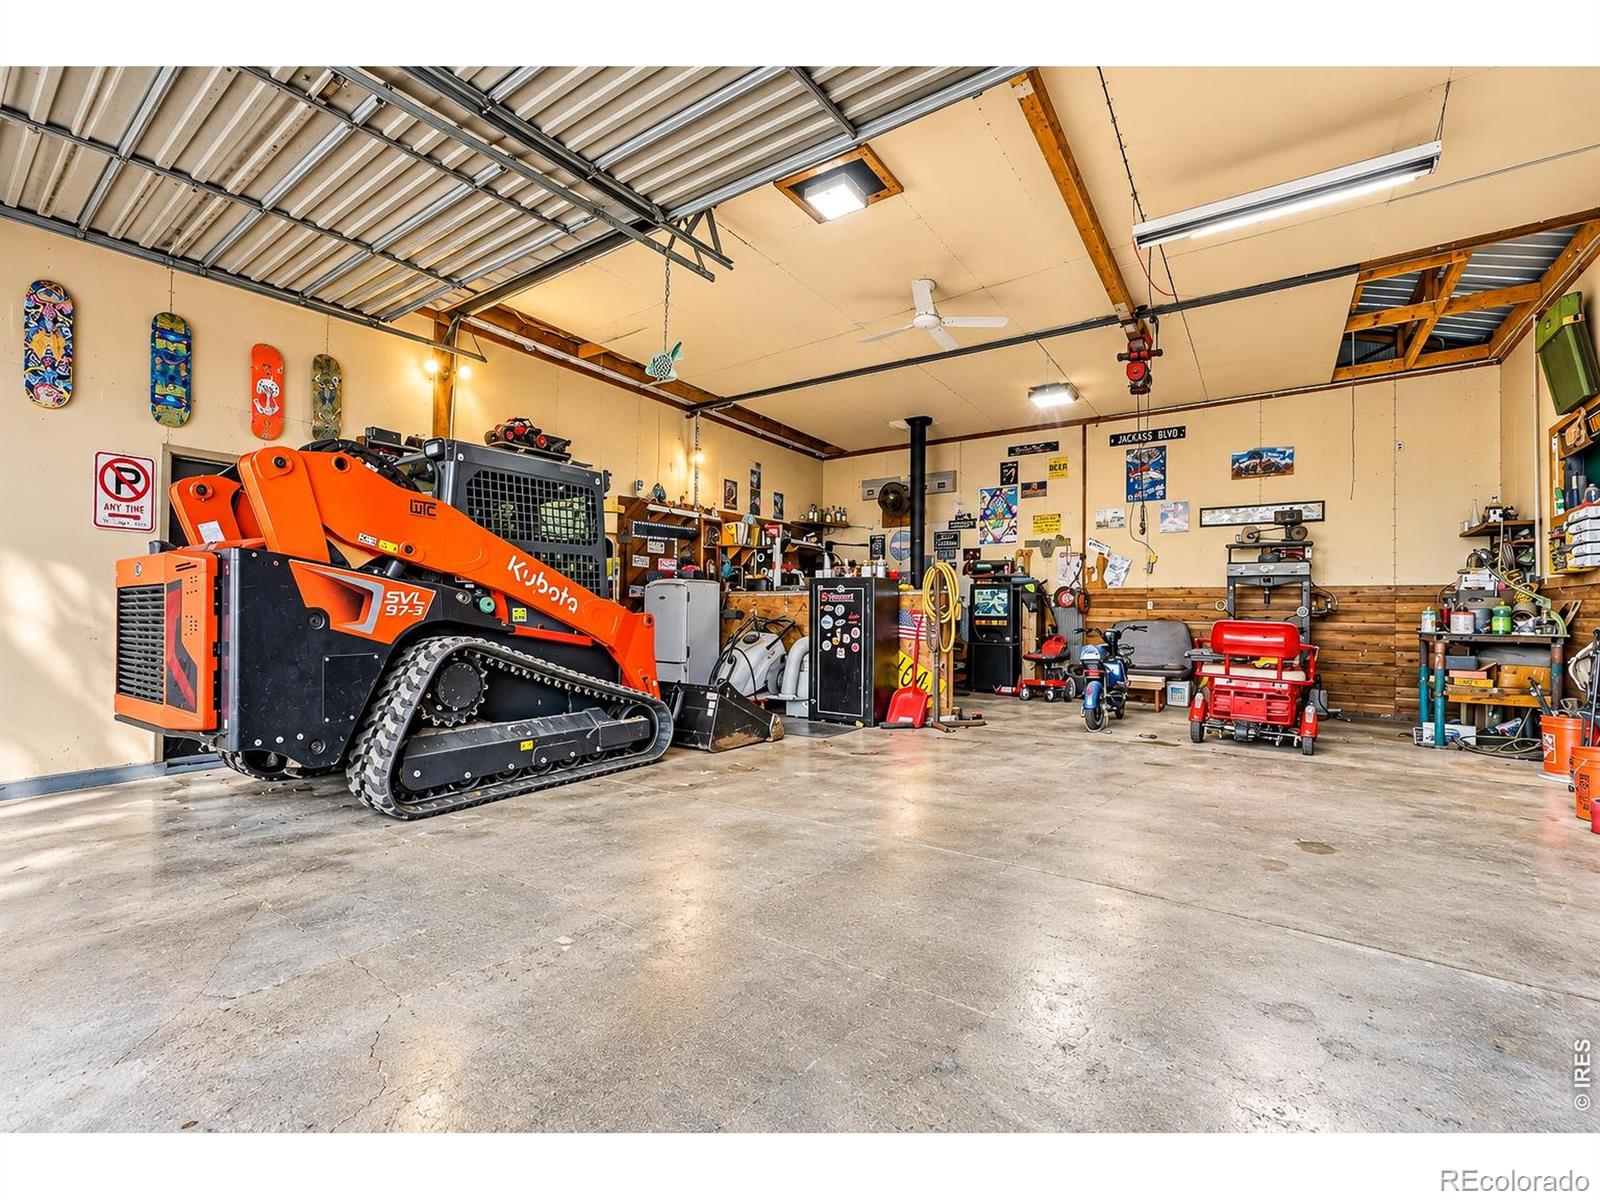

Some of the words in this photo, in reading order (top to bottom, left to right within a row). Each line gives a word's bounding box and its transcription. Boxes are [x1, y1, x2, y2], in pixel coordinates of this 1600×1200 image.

[1118, 431, 1153, 444] JACKASS
[1158, 428, 1178, 440] BLVD
[103, 502, 122, 512] ANY
[125, 504, 145, 514] TIME
[507, 554, 578, 614] Kubota
[384, 591, 425, 605] SVL
[384, 605, 424, 616] 97-3
